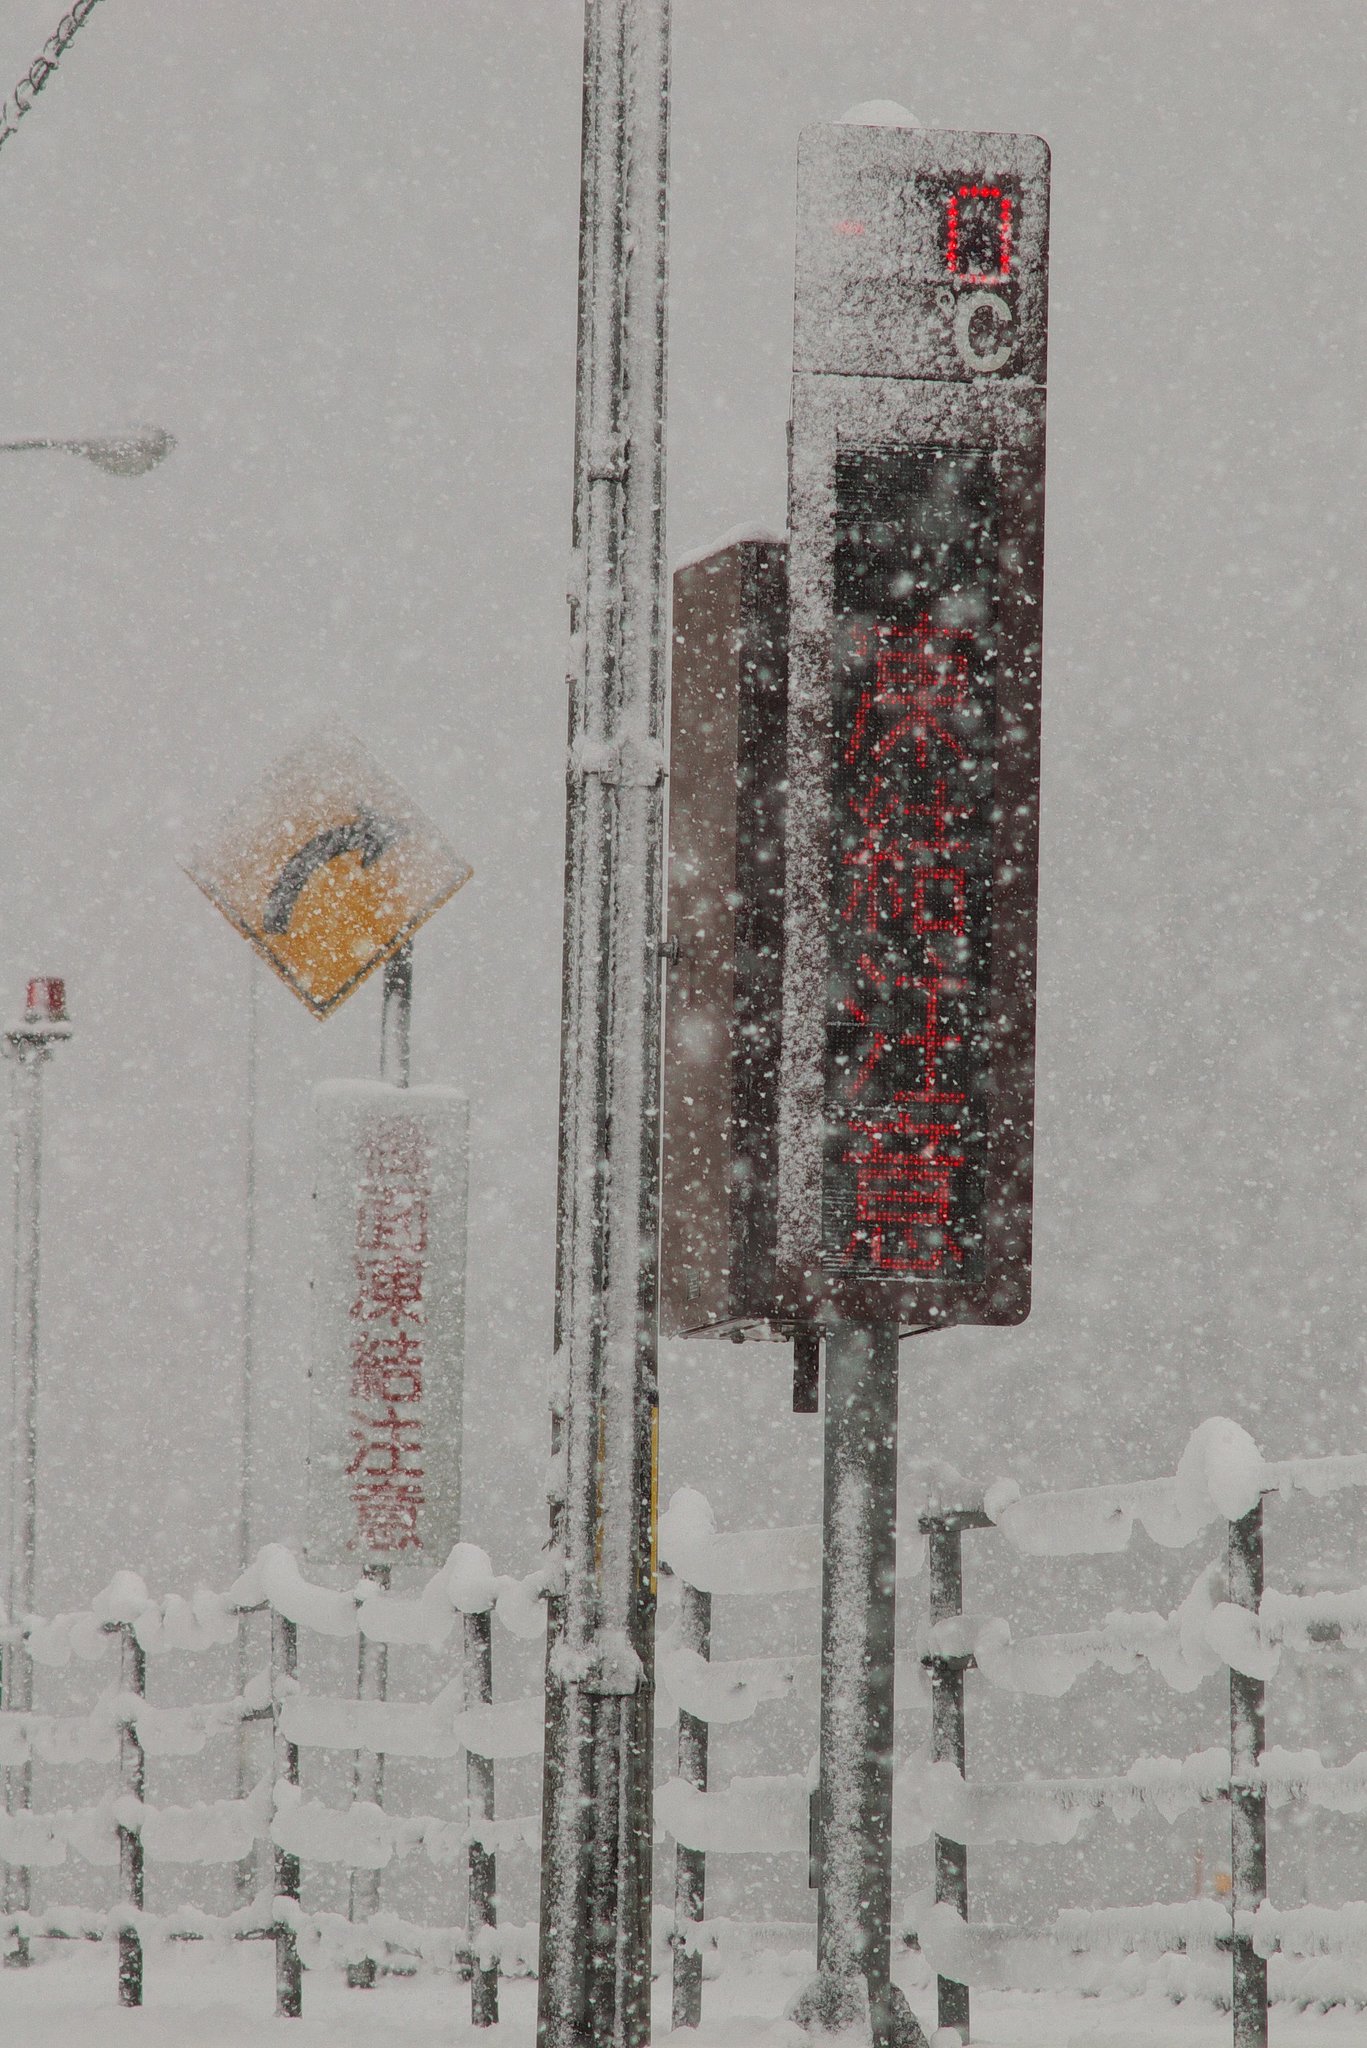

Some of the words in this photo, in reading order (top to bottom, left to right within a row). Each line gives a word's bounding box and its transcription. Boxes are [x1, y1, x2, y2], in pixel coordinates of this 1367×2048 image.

[841, 611, 977, 1271] 凍結注意
[346, 1114, 431, 1551] 面凍結注意
